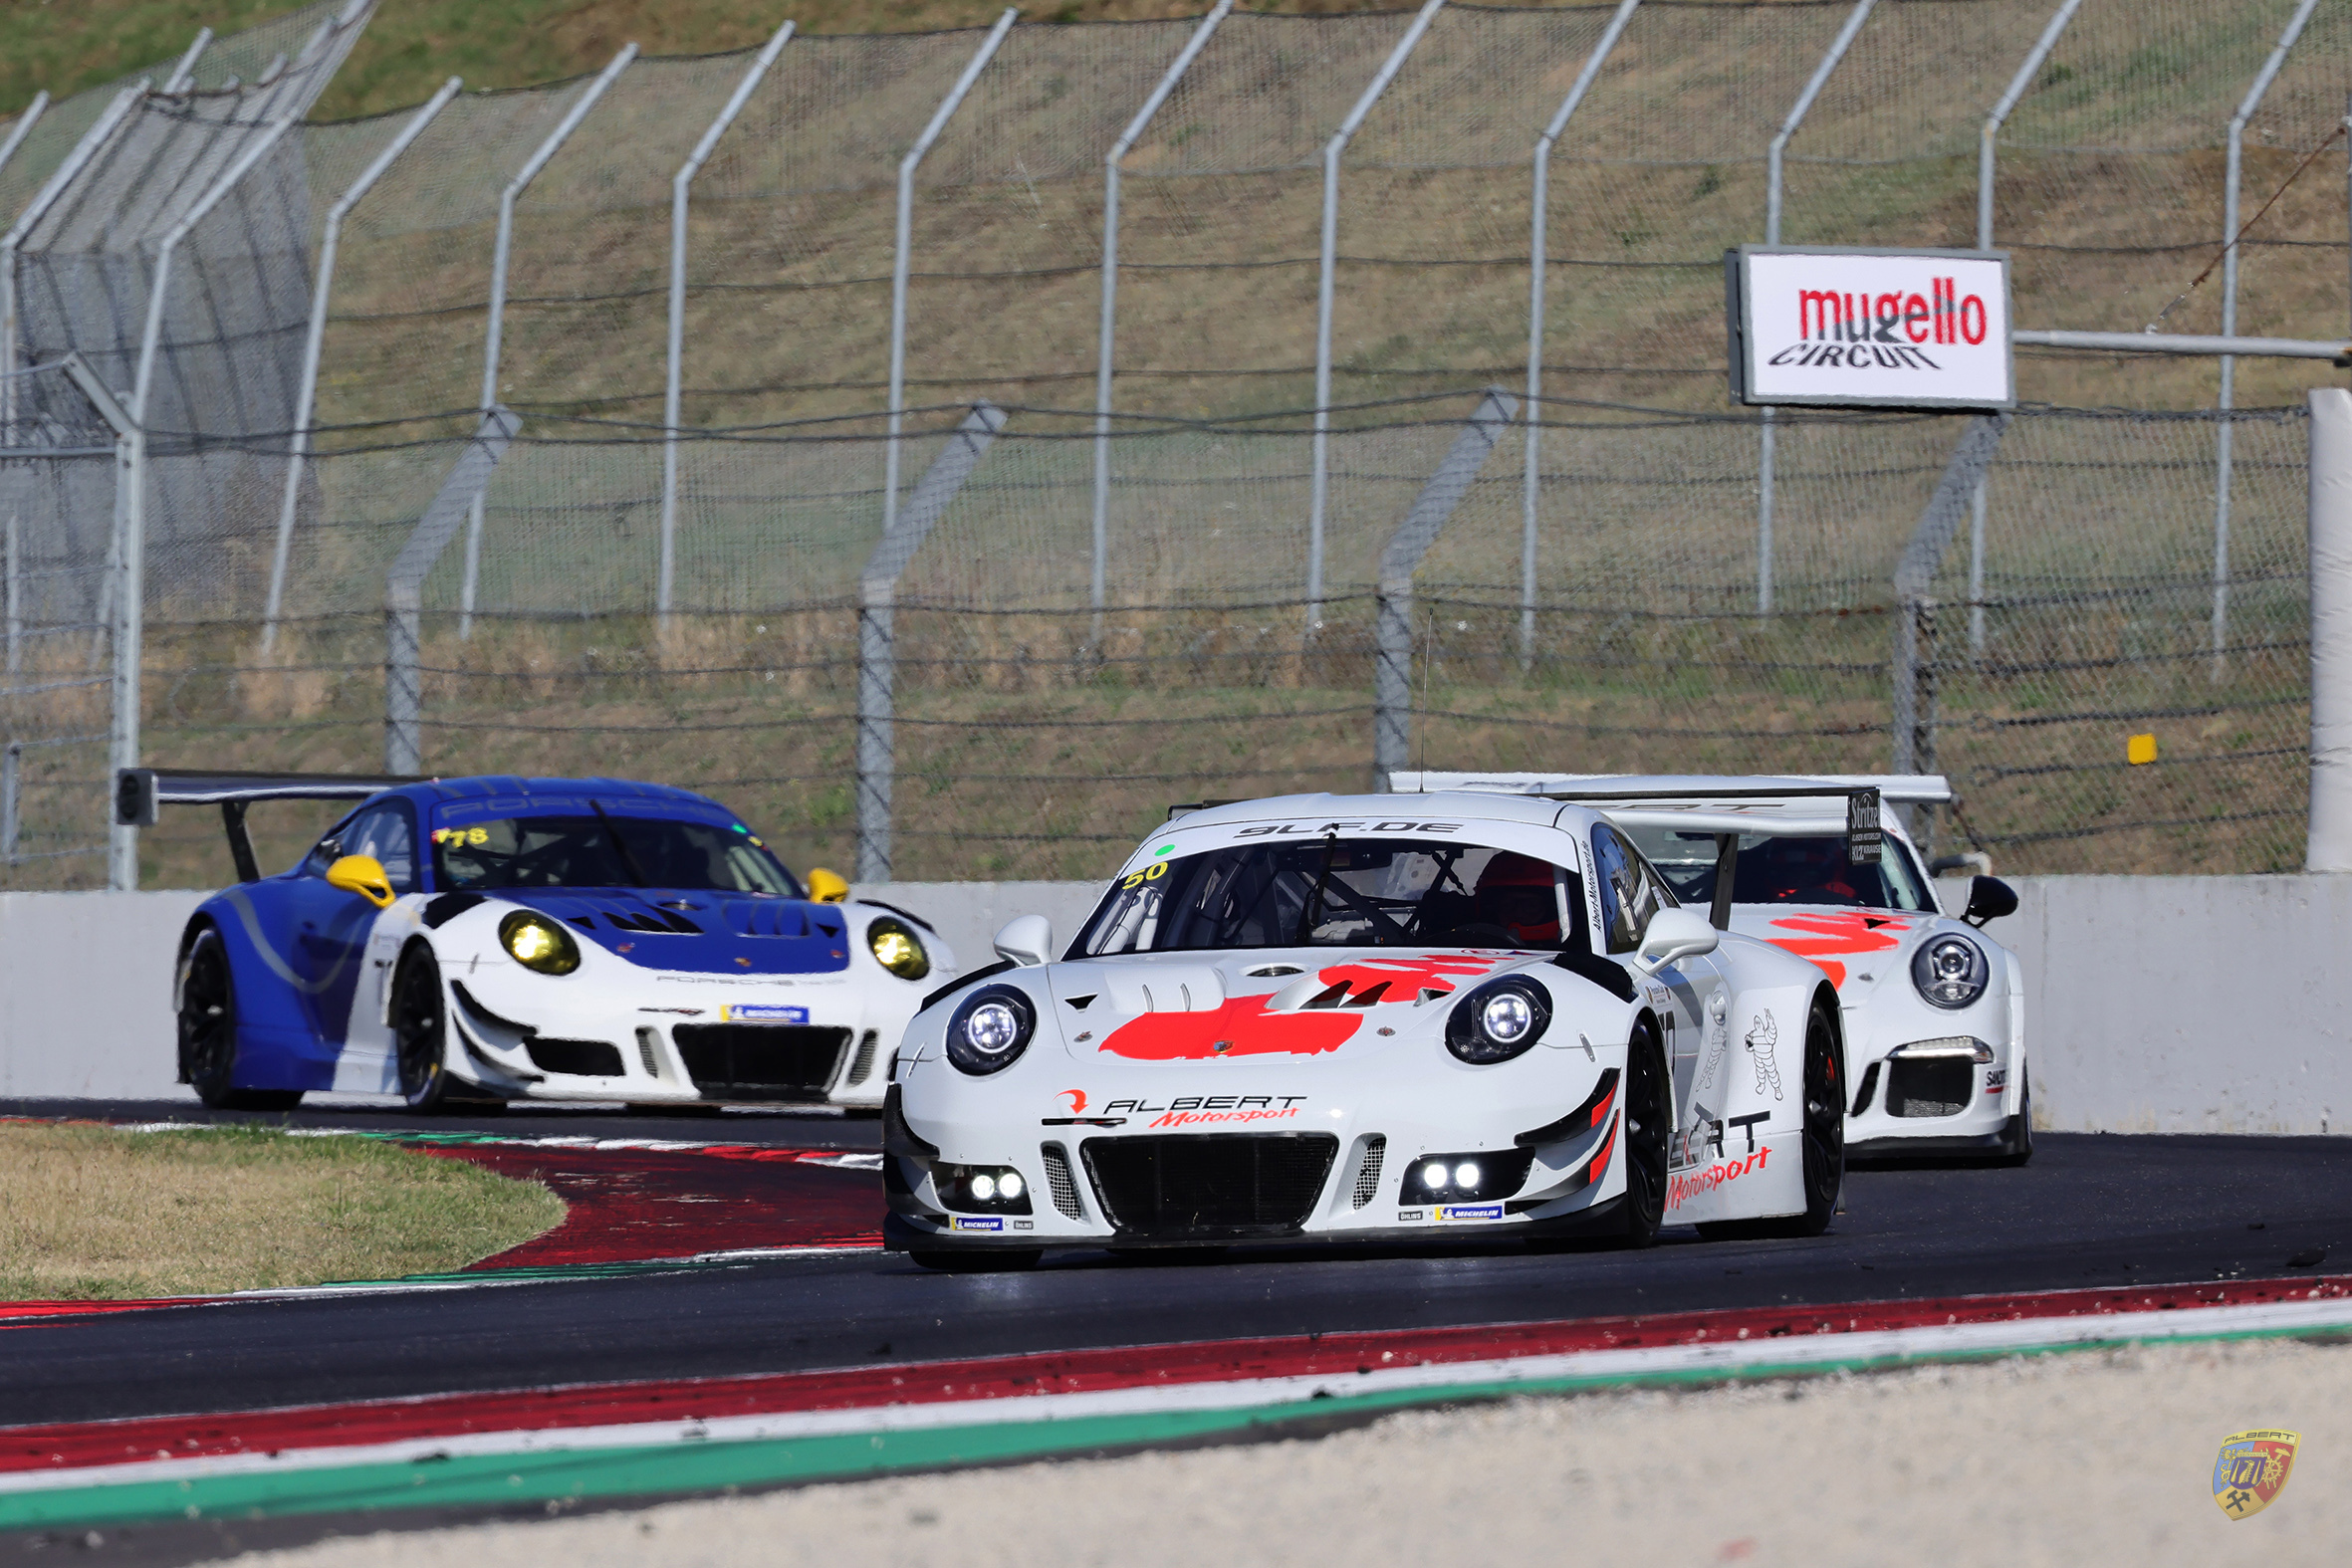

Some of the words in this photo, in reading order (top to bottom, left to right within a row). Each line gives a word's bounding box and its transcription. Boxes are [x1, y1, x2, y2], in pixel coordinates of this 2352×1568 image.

[1799, 277, 1987, 344] mugello
[1768, 343, 1942, 370] CIRCUIT
[1122, 861, 1169, 890] 50
[1102, 1096, 1308, 1115] ALBERT
[1148, 1107, 1300, 1129] Motorsport
[1664, 1147, 1771, 1213] Motorsport
[963, 1221, 999, 1230] MICHELIN
[1455, 1209, 1499, 1219] MICHELIN
